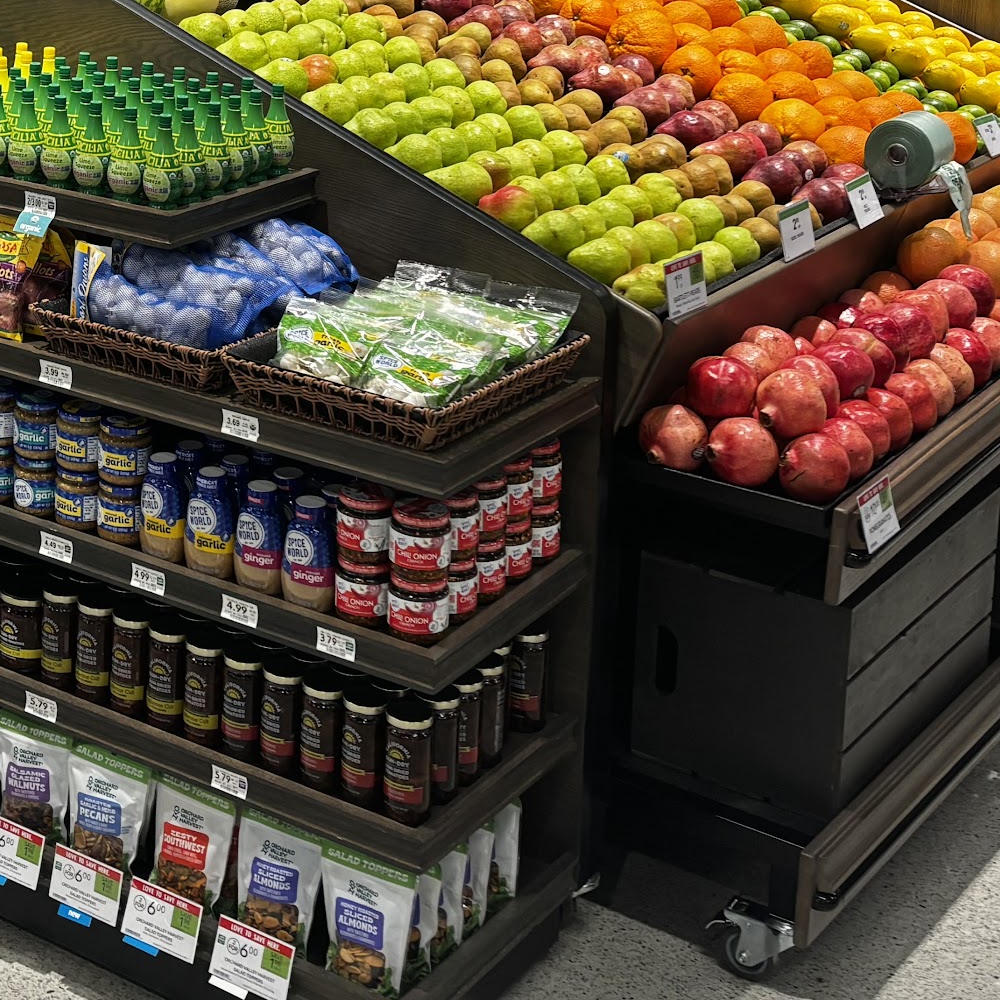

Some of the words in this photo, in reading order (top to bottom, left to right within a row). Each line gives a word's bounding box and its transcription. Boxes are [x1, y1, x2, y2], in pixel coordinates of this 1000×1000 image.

[115, 164, 128, 172] Lime
[19, 222, 42, 234] organic
[44, 366, 59, 376] 3.99
[226, 417, 240, 427] 3.69
[18, 432, 45, 444] garlic
[58, 443, 82, 455] garlic
[189, 505, 208, 516] SPICE
[190, 514, 211, 526] WORLD
[239, 519, 257, 531] SPICE
[146, 520, 171, 535] garlic
[239, 529, 259, 541] WORLD
[196, 536, 226, 550] garlic
[244, 552, 274, 566] ginger
[412, 551, 437, 562] ONION
[134, 571, 150, 582] 4.99
[293, 569, 324, 584] ginger
[226, 600, 248, 615] 4.99
[349, 597, 374, 608] ONION
[404, 615, 429, 626] ONION
[320, 633, 337, 646] 3.79
[29, 699, 48, 710] 5.79
[19, 747, 44, 759] ORCHARD
[76, 745, 104, 763] SALAD
[104, 755, 144, 779] TOPPERS
[9, 766, 46, 779] BALSAMIC
[11, 772, 41, 783] GLAZED
[214, 770, 231, 783] 5.79
[8, 777, 46, 793] WALNUTS
[79, 807, 116, 824] PECANS
[170, 829, 198, 841] ZESTY
[164, 833, 206, 854] SOUTHWEST
[327, 848, 361, 866] SALAD
[361, 858, 409, 883] TOPPERS
[257, 868, 286, 882] SLICED
[253, 873, 291, 891] ALMONDS
[355, 882, 379, 898] ORCHARD
[355, 888, 373, 899] VALLEY
[142, 884, 155, 895] LOVE
[156, 890, 163, 899] TO
[163, 893, 175, 905] SAVE
[176, 899, 189, 911] HERE.
[354, 892, 377, 907] HARVEST
[134, 901, 145, 910] FOR
[67, 909, 81, 919] new
[343, 908, 374, 924] SLICED
[338, 914, 378, 936] ALMONDS
[230, 923, 243, 934] LOVE
[244, 930, 252, 938] TO
[253, 933, 266, 945] SAVE
[266, 939, 281, 951] HERE.
